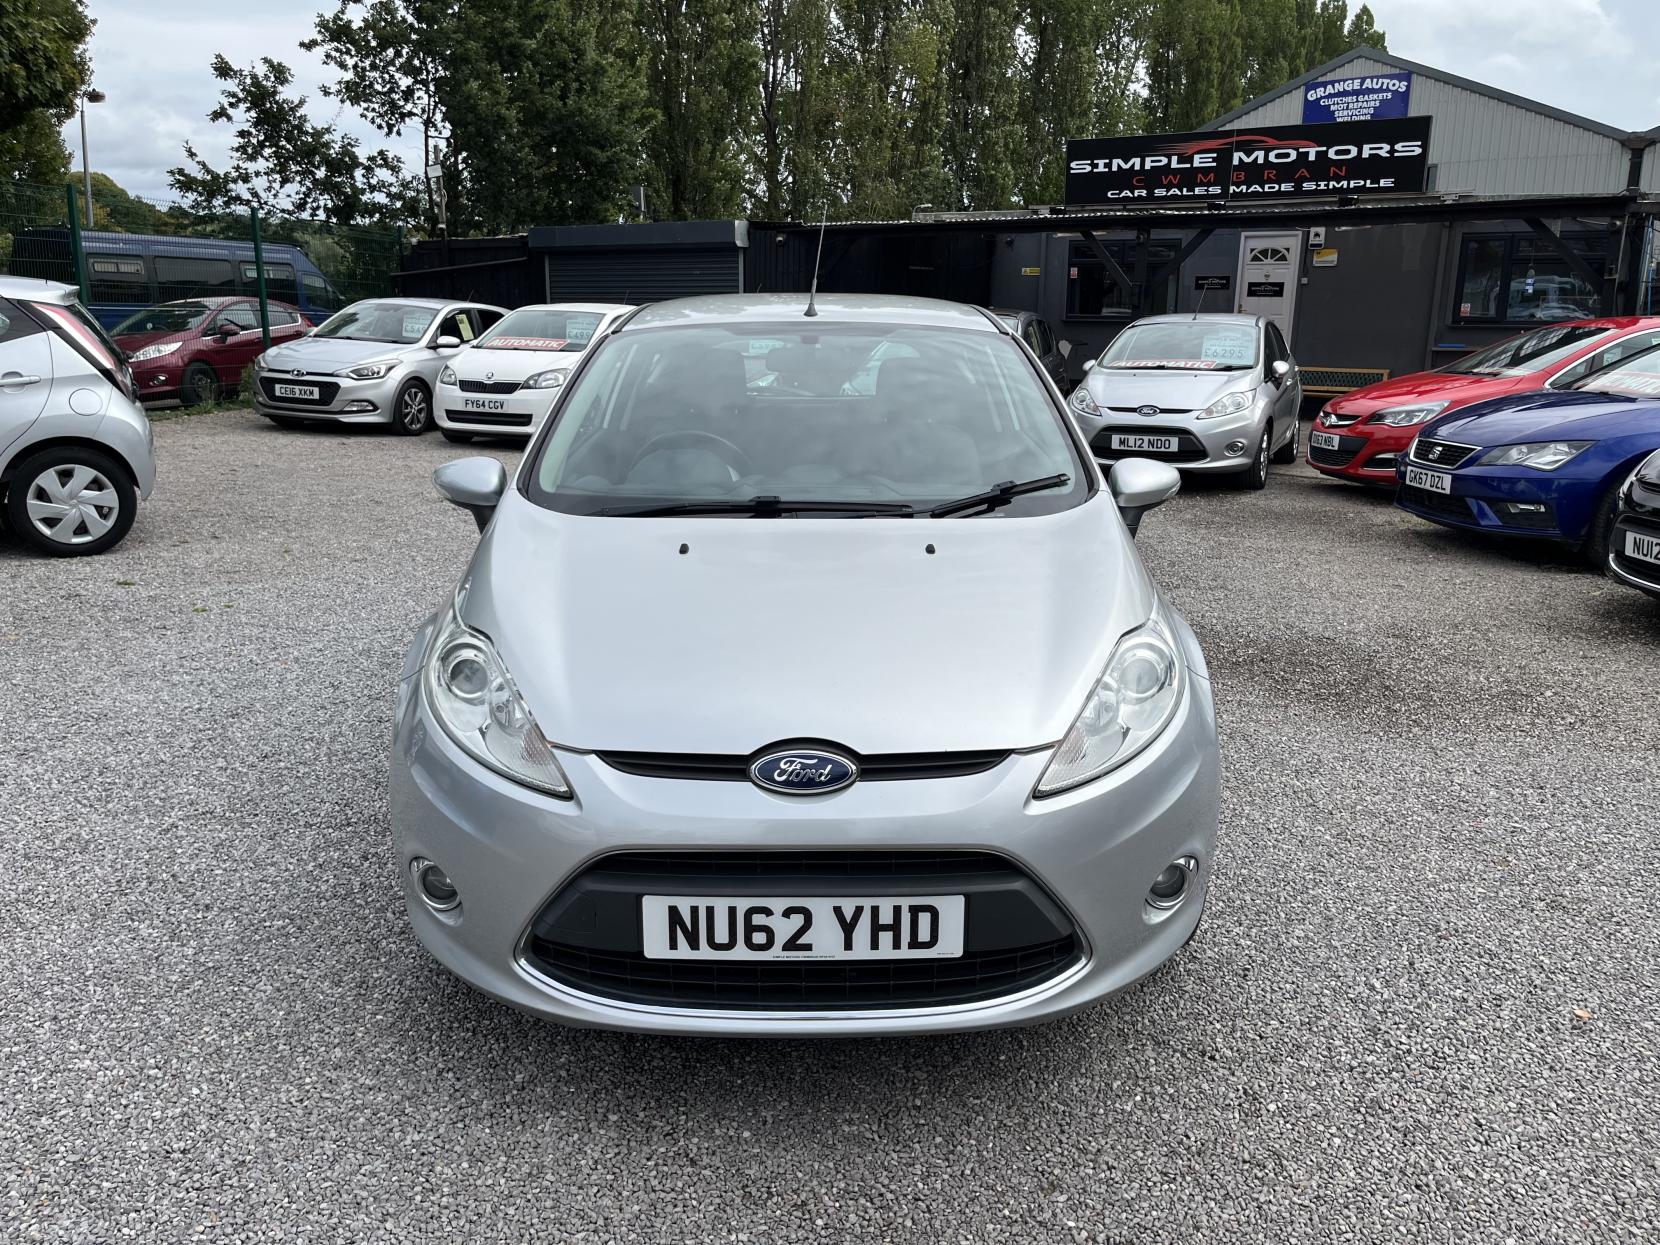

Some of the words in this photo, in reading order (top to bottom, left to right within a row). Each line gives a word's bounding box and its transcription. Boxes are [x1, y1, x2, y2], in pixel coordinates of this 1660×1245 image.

[1307, 79, 1361, 101] GRANGE
[1362, 78, 1408, 92] AUTOS
[1320, 95, 1357, 106] CLUTCHES
[1357, 92, 1392, 102] GASKETS
[1330, 103, 1348, 111] MOT
[1348, 100, 1380, 109] REPAIRS
[1334, 107, 1374, 118] SERVICING
[1070, 153, 1217, 174] SIMPLE
[1232, 141, 1423, 166] MOTORS
[1132, 165, 1346, 187] CWMBRAN
[1107, 189, 1147, 198] CAR
[1154, 186, 1222, 197] SALES
[1229, 182, 1295, 194] MADE
[1302, 178, 1395, 191] SIMPLE
[490, 338, 561, 348] AUTOMATIC
[1113, 360, 1211, 369] AUTOMATIC
[279, 386, 297, 397] CE16
[298, 387, 315, 398] XKM
[464, 399, 486, 410] FY64
[488, 400, 505, 410] CGV
[1118, 437, 1145, 449] ML12
[1147, 438, 1171, 450] NDO
[1408, 469, 1429, 487] GK67
[1429, 474, 1446, 491] DZL
[773, 757, 833, 783] Ford
[667, 905, 813, 952] NU62
[832, 904, 940, 952] YHD
